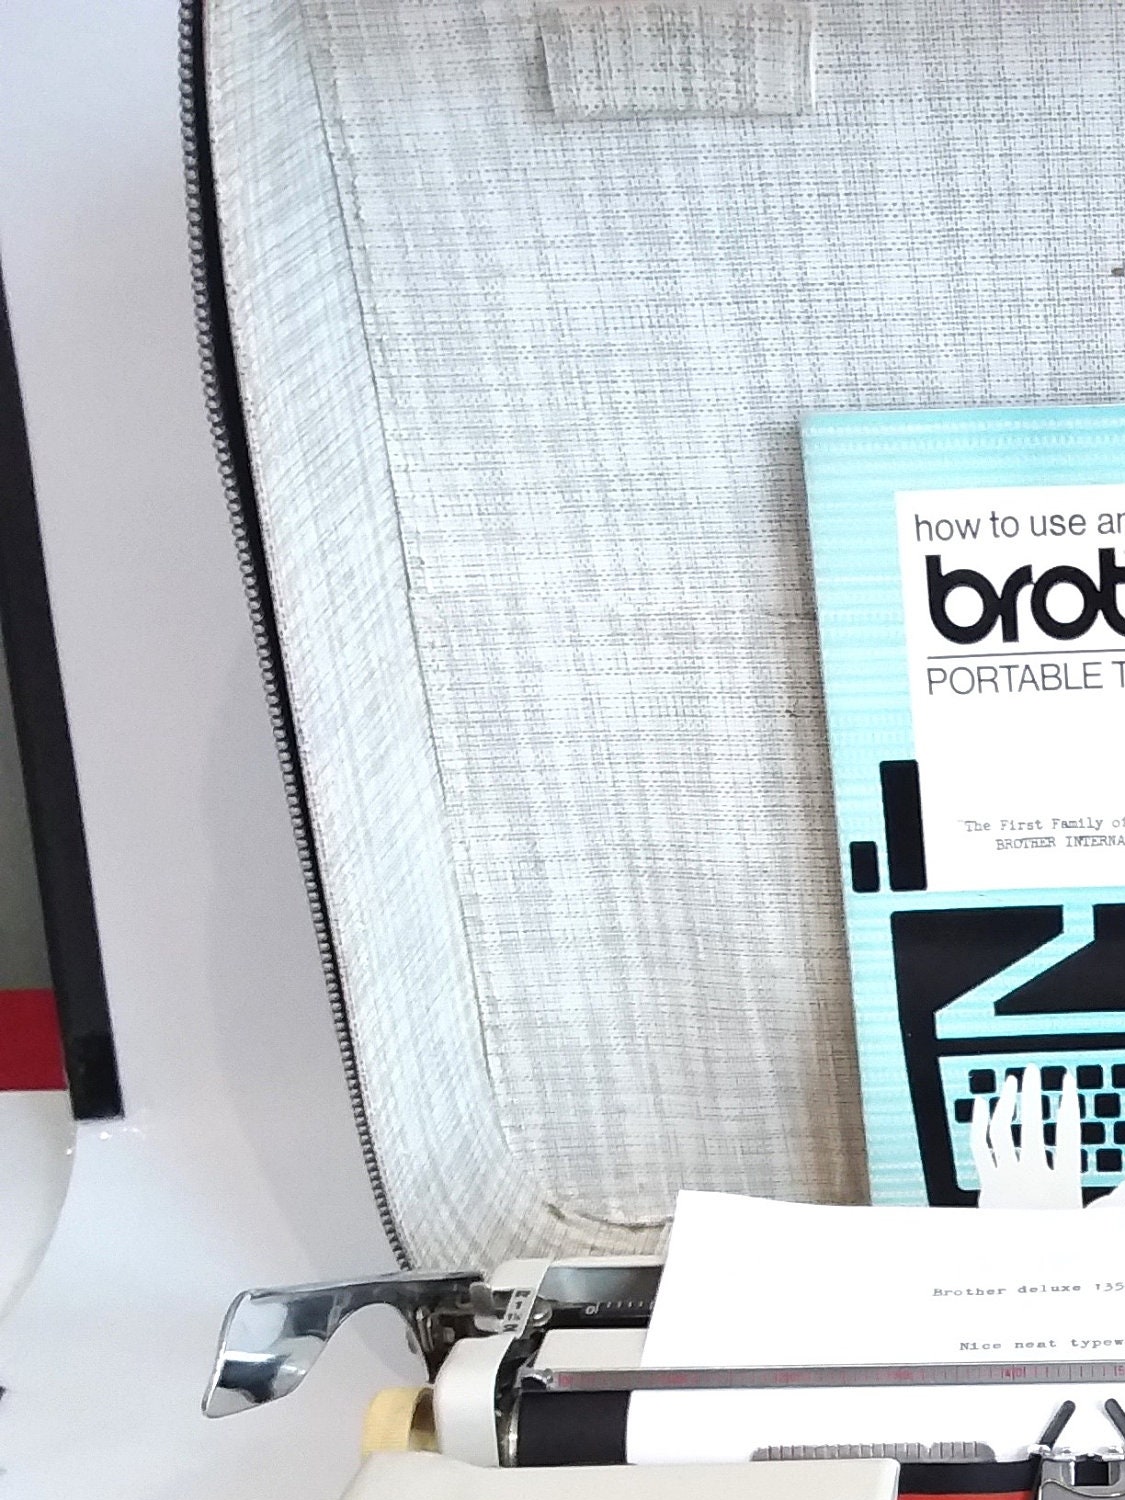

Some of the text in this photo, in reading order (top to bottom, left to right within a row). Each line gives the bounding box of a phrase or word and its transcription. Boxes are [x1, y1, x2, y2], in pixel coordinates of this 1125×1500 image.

[915, 514, 980, 541] how
[989, 511, 1019, 538] to
[1030, 514, 1086, 536] use
[927, 658, 1103, 695] PORTABLE
[1000, 819, 1043, 831] First
[1052, 817, 1104, 831] Family
[996, 837, 1056, 850] BROTHER
[933, 1287, 1007, 1297] Brother
[1019, 1284, 1081, 1294] deluxe
[960, 1341, 1003, 1351] Nice
[1014, 1339, 1057, 1348] neat
